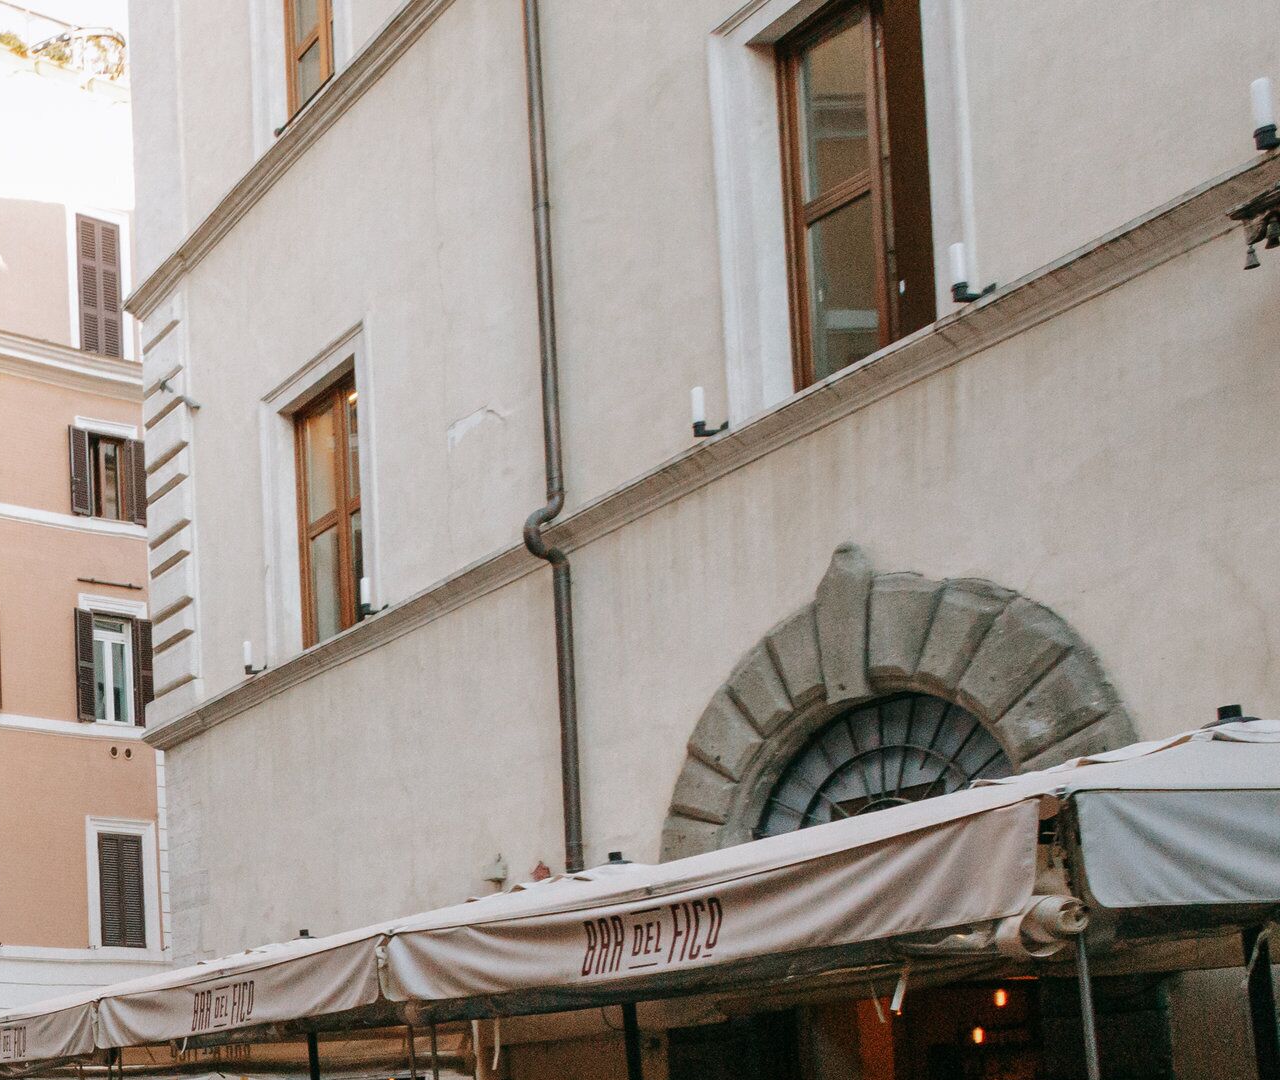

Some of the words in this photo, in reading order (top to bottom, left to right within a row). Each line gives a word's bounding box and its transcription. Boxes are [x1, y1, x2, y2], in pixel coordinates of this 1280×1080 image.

[582, 914, 625, 977] BAR
[631, 920, 662, 957] DEL
[667, 897, 723, 964] FICO
[191, 989, 212, 1032] BAR
[214, 995, 228, 1019] DEL
[230, 980, 255, 1025] FICO
[13, 1026, 26, 1059] FICO
